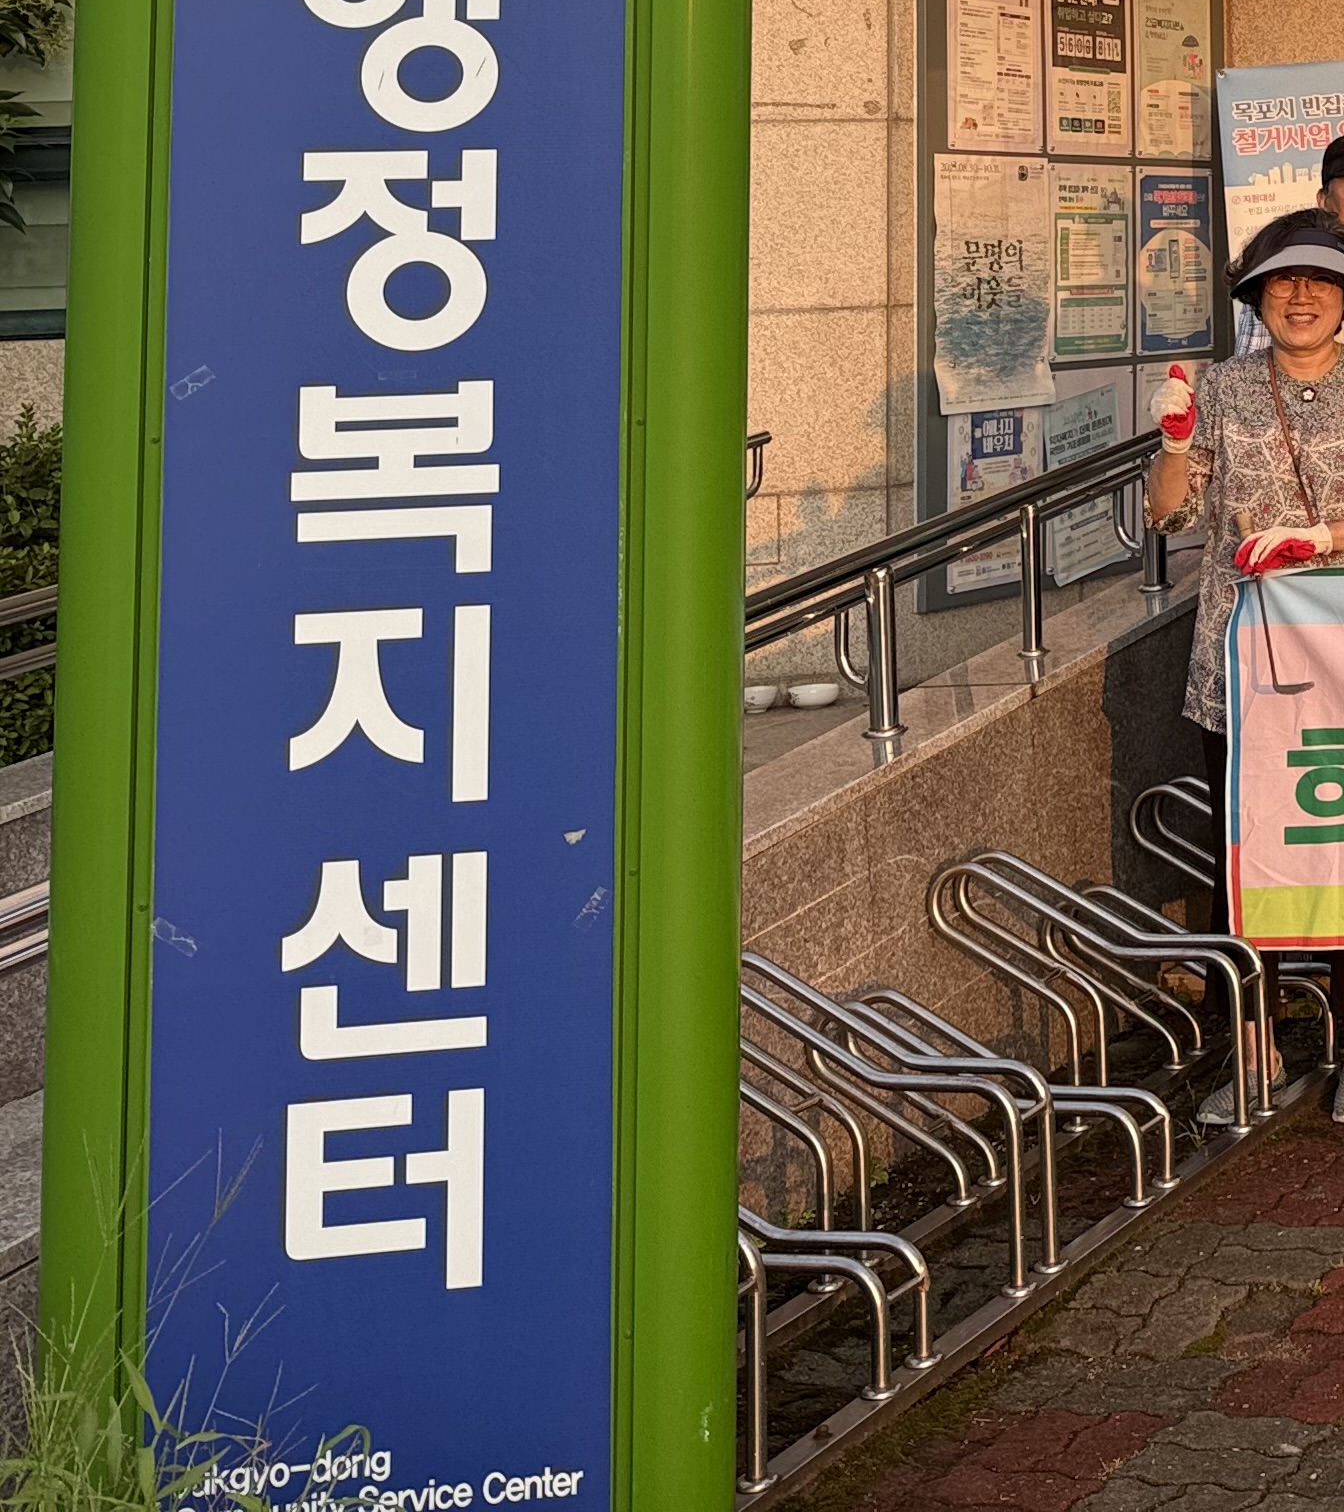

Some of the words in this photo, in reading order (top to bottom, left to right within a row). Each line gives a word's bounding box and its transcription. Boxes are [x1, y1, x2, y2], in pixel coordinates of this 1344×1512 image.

[1232, 97, 1296, 123] 목포시
[1232, 121, 1333, 156] 철거사업
[961, 239, 1024, 273] 문명의
[982, 417, 1014, 437] 에너지
[982, 434, 1014, 454] 바우처
[174, 1450, 392, 1499] ukgyo-dong
[358, 1478, 474, 1512] Service
[482, 1466, 584, 1505] Center
